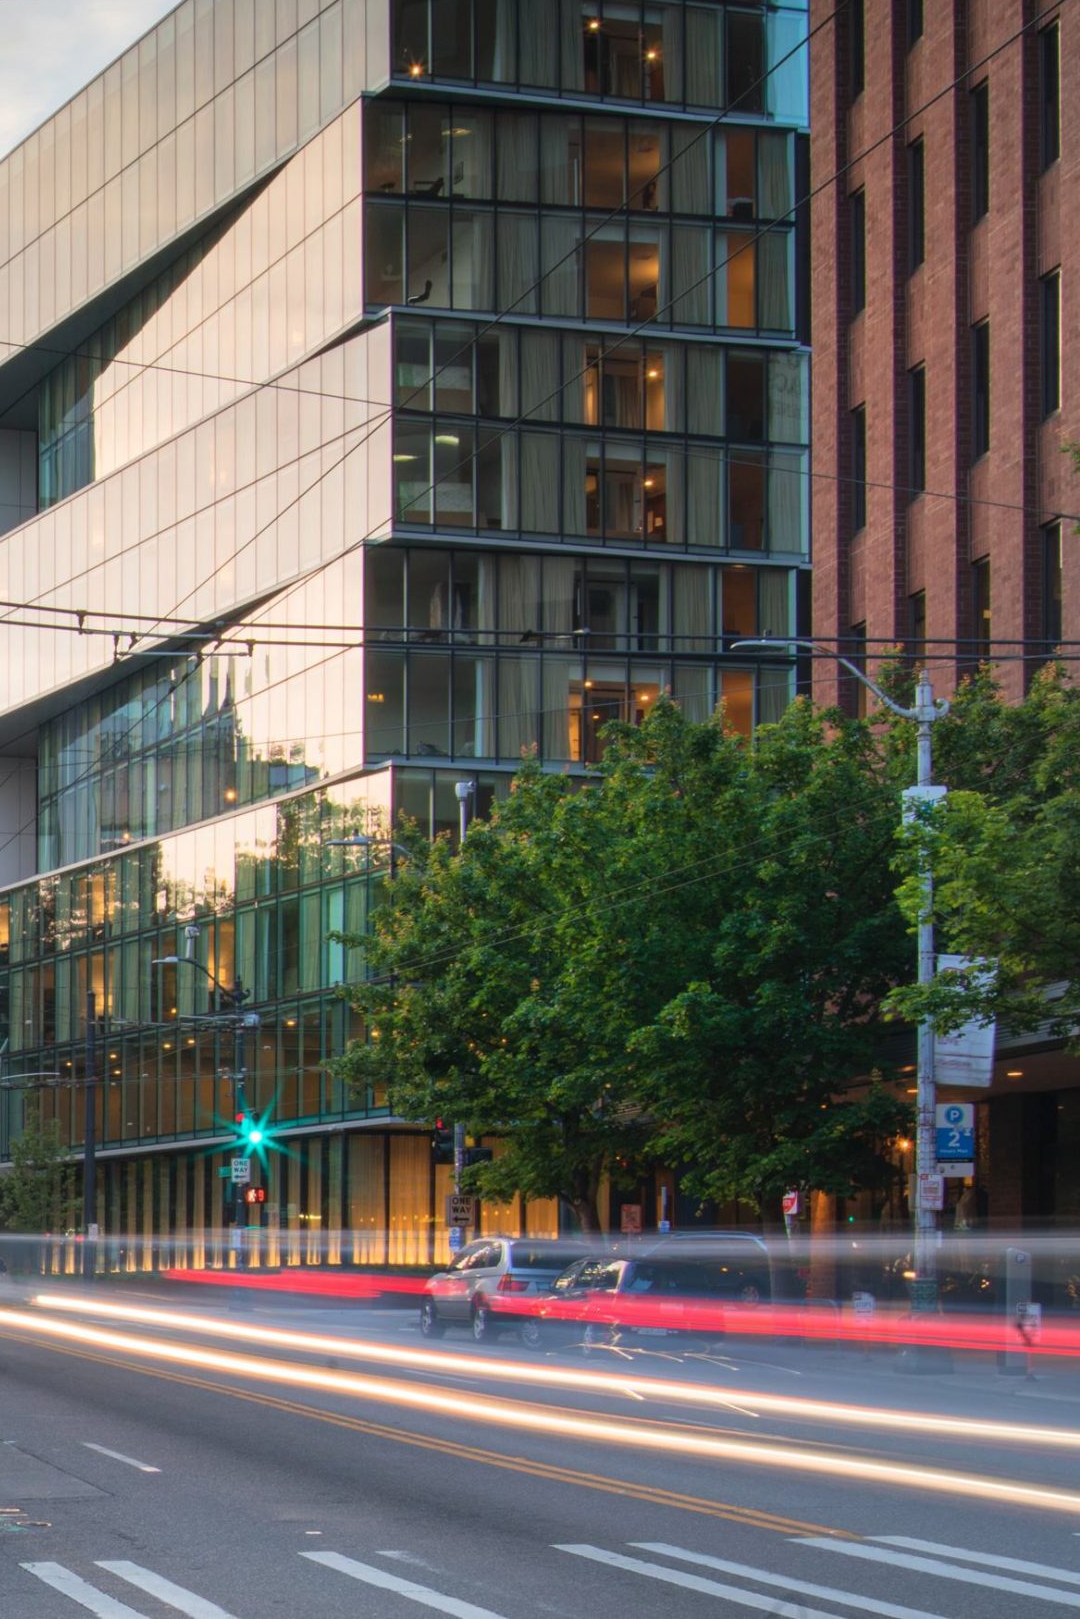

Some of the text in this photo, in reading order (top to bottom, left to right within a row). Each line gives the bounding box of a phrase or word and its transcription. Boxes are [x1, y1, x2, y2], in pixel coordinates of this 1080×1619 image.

[950, 1110, 960, 1121] P
[948, 1132, 961, 1147] 2
[452, 1197, 471, 1205] ONE
